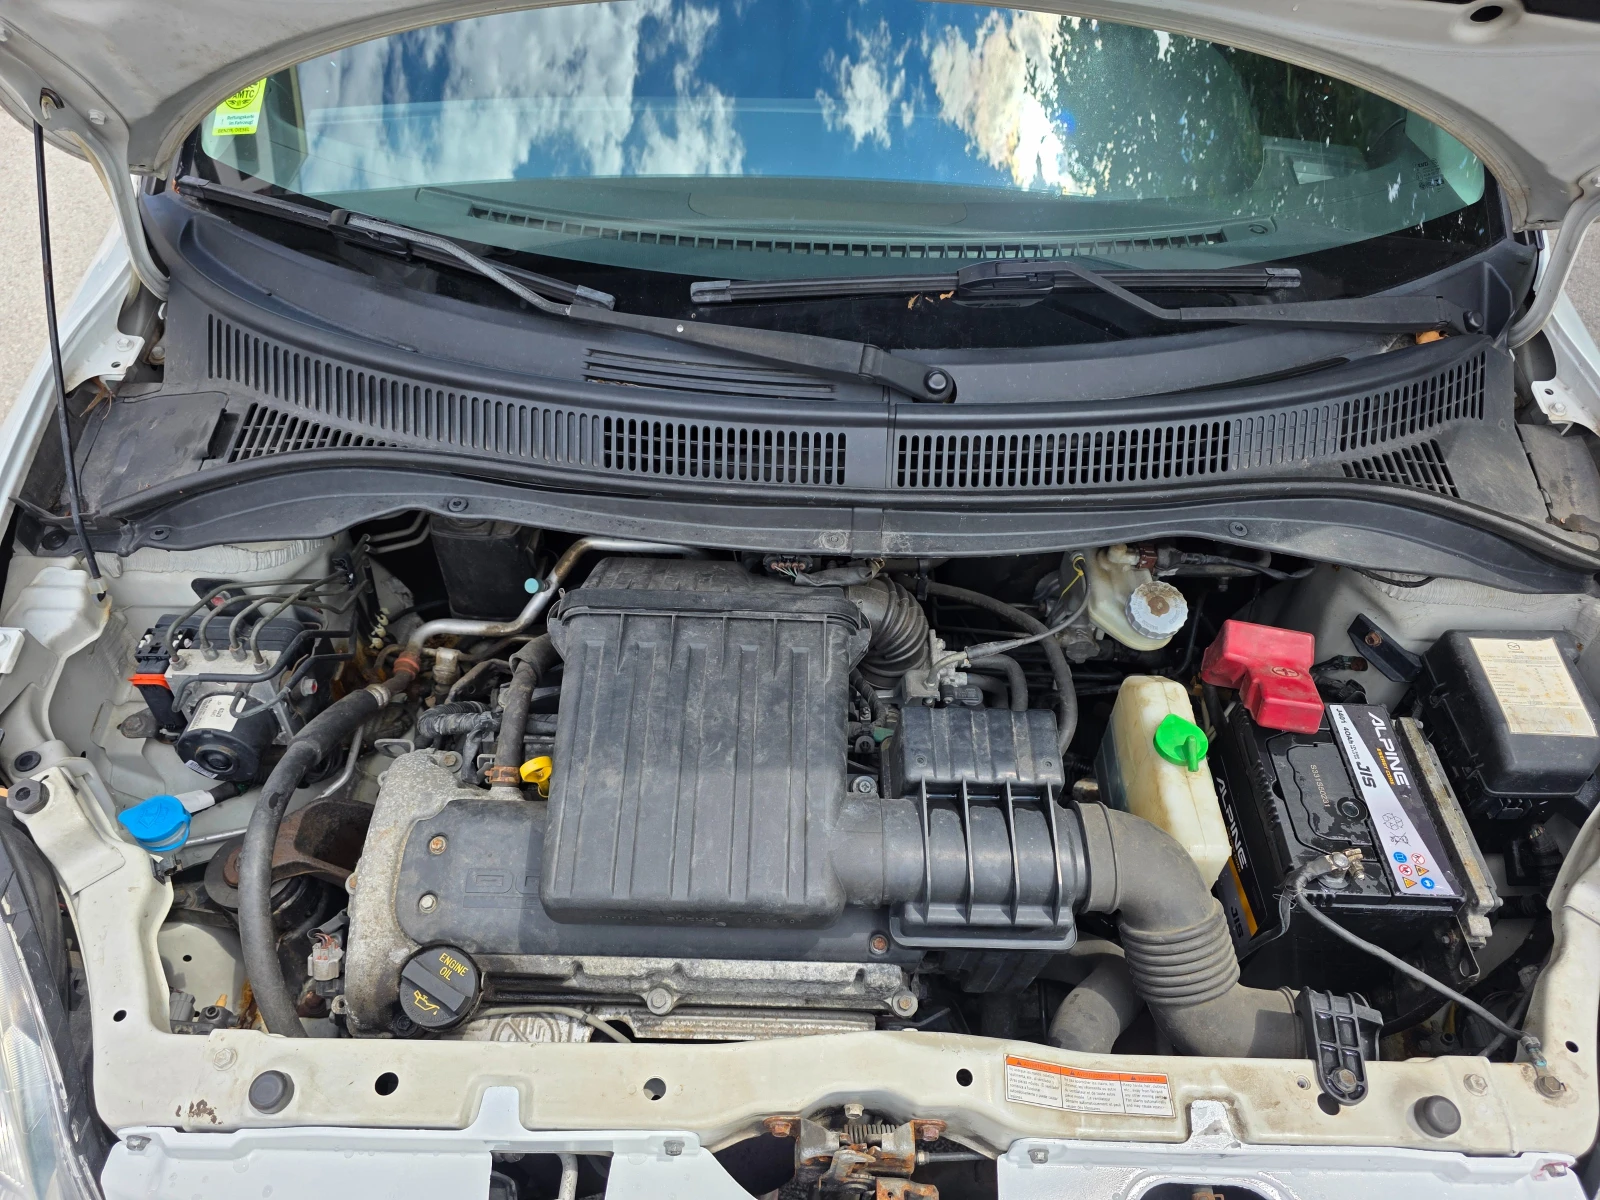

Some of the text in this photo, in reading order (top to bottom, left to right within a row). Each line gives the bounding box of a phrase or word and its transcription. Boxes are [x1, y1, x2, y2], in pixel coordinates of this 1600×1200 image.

[232, 89, 255, 99] AMTC
[1368, 711, 1410, 786] ALPINE
[1356, 761, 1377, 788] JIS
[1216, 776, 1248, 870] ALPINE
[1230, 905, 1244, 939] JIS
[439, 952, 469, 977] ENGINE
[439, 966, 454, 981] OIL
